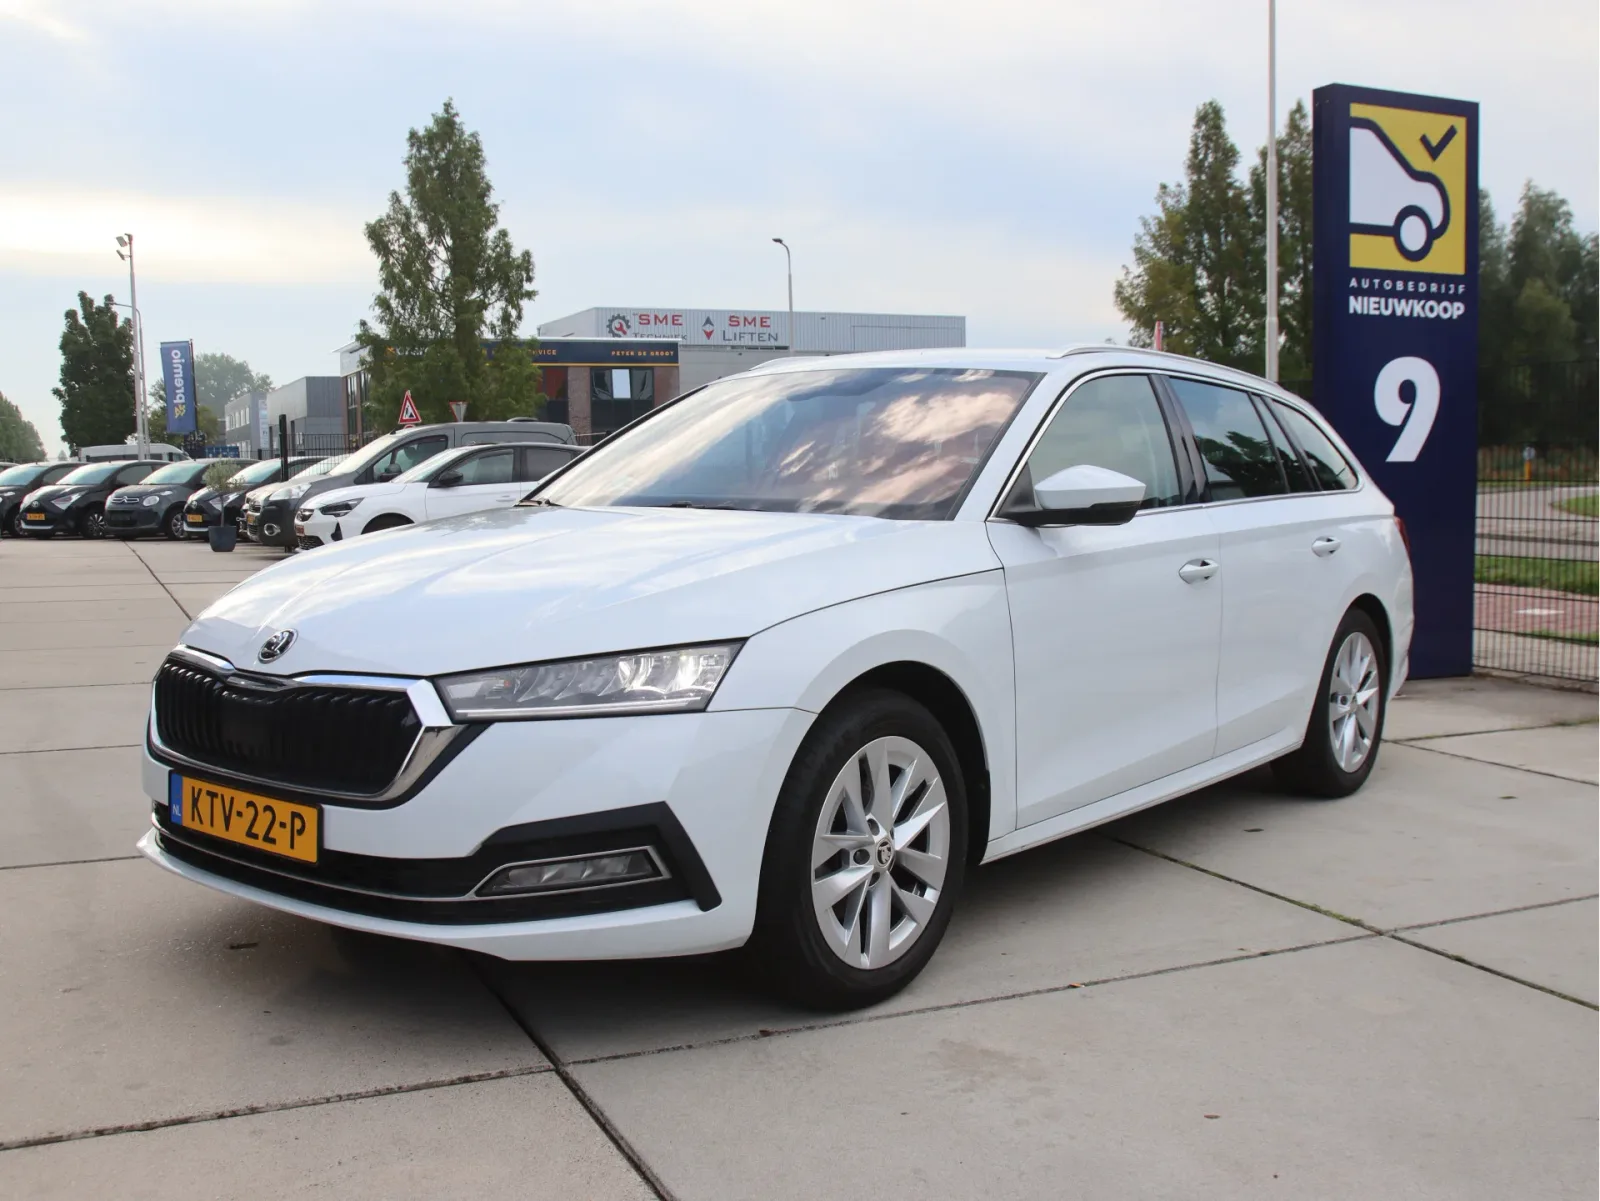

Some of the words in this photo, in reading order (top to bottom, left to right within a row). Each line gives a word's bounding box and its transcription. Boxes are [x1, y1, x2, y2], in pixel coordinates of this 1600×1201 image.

[1349, 277, 1466, 294] AUTOBEDRIJF
[1349, 295, 1466, 320] NIEUWKOOP
[638, 313, 683, 326] SME
[728, 314, 771, 328] SME
[722, 330, 778, 342] LIFTEN
[1373, 355, 1441, 462] 9
[172, 803, 182, 817] NL
[191, 785, 307, 850] KTV-22-P
